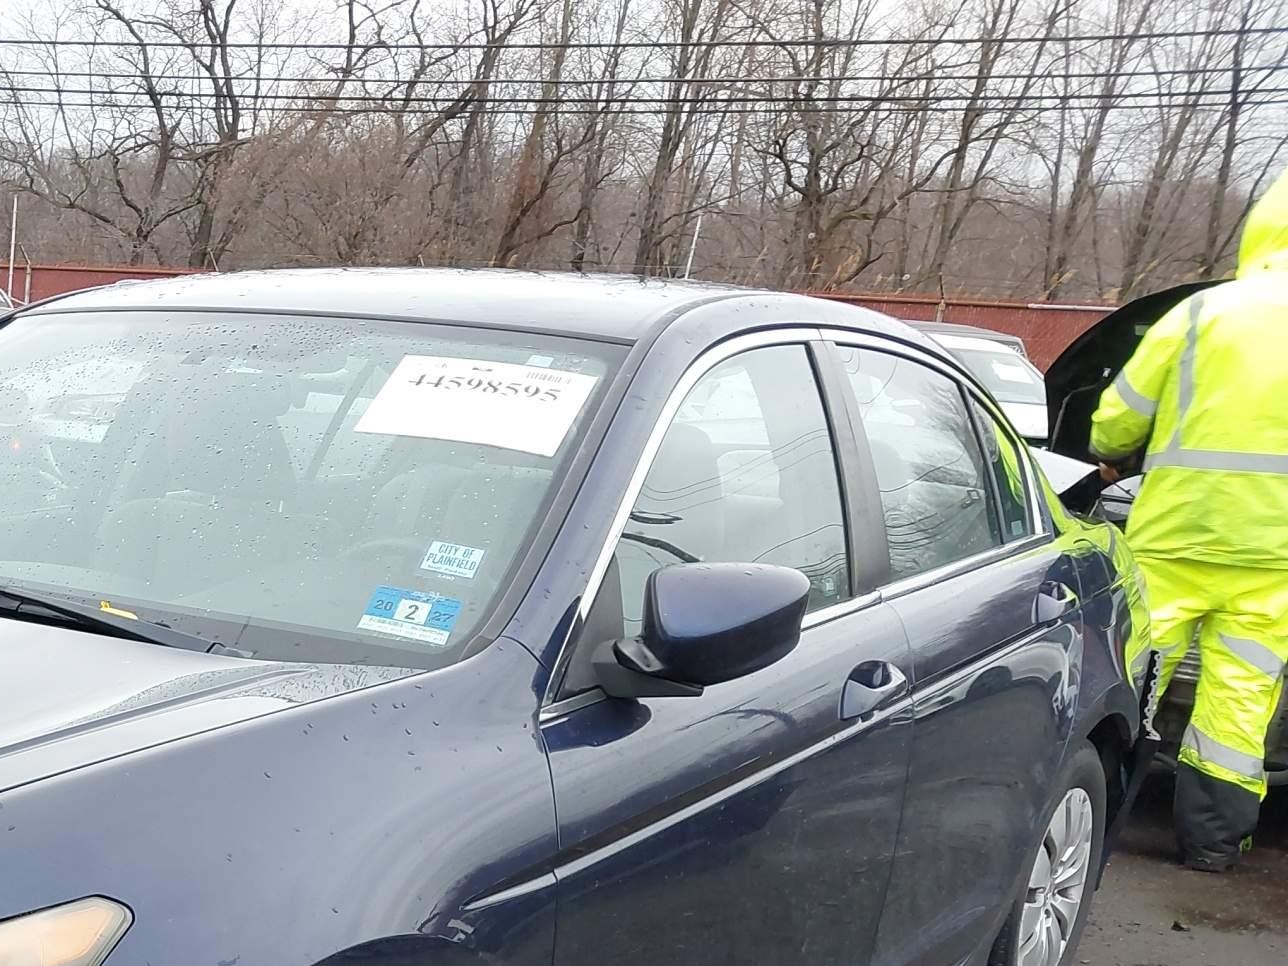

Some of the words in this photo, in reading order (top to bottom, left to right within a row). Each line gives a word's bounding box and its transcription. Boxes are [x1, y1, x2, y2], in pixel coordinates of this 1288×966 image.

[408, 373, 562, 402] 44598595
[425, 552, 477, 571] PLAINFIELD
[438, 543, 461, 556] CITY
[462, 548, 477, 559] OF
[374, 599, 394, 612] 20
[404, 604, 419, 621] 2
[431, 610, 455, 623] 27
